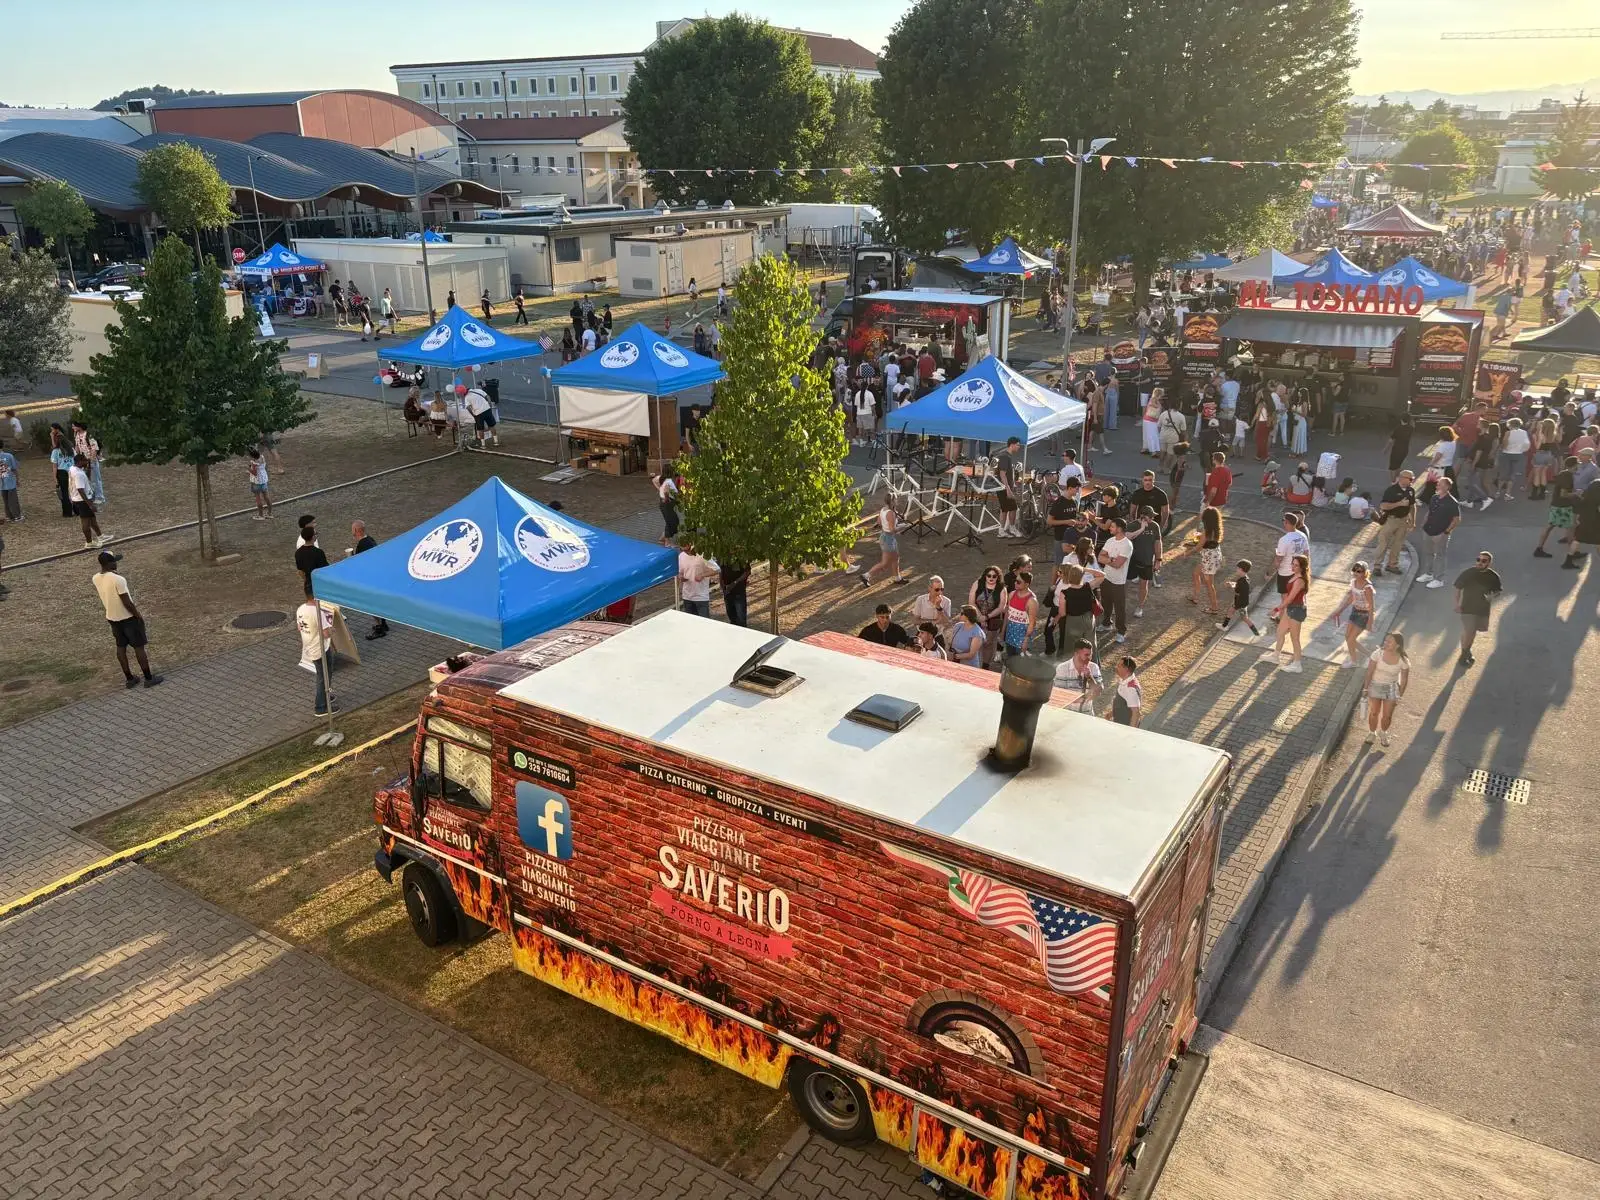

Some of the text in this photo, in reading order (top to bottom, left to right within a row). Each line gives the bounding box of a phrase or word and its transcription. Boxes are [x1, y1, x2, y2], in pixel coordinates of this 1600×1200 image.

[1239, 279, 1424, 315] AL TOSKANO
[953, 396, 983, 405] MWR
[418, 550, 459, 569] MWR
[540, 541, 580, 562] MWR
[528, 763, 570, 784] 329 7810604
[639, 764, 807, 831] PIZZA CATERING GIROPIZZA EVENTI
[423, 817, 471, 851] SAVERIO
[693, 816, 745, 847] PIZZERIA
[526, 851, 568, 879] PIZZERIA
[677, 826, 762, 873] VIAGGIANTE
[521, 863, 575, 898] VIAGGIANTE
[713, 860, 726, 876] DA
[522, 879, 576, 913] DA SAVERIO
[658, 844, 790, 934] SAVERIO
[670, 904, 771, 955] FORNO A LEGNA
